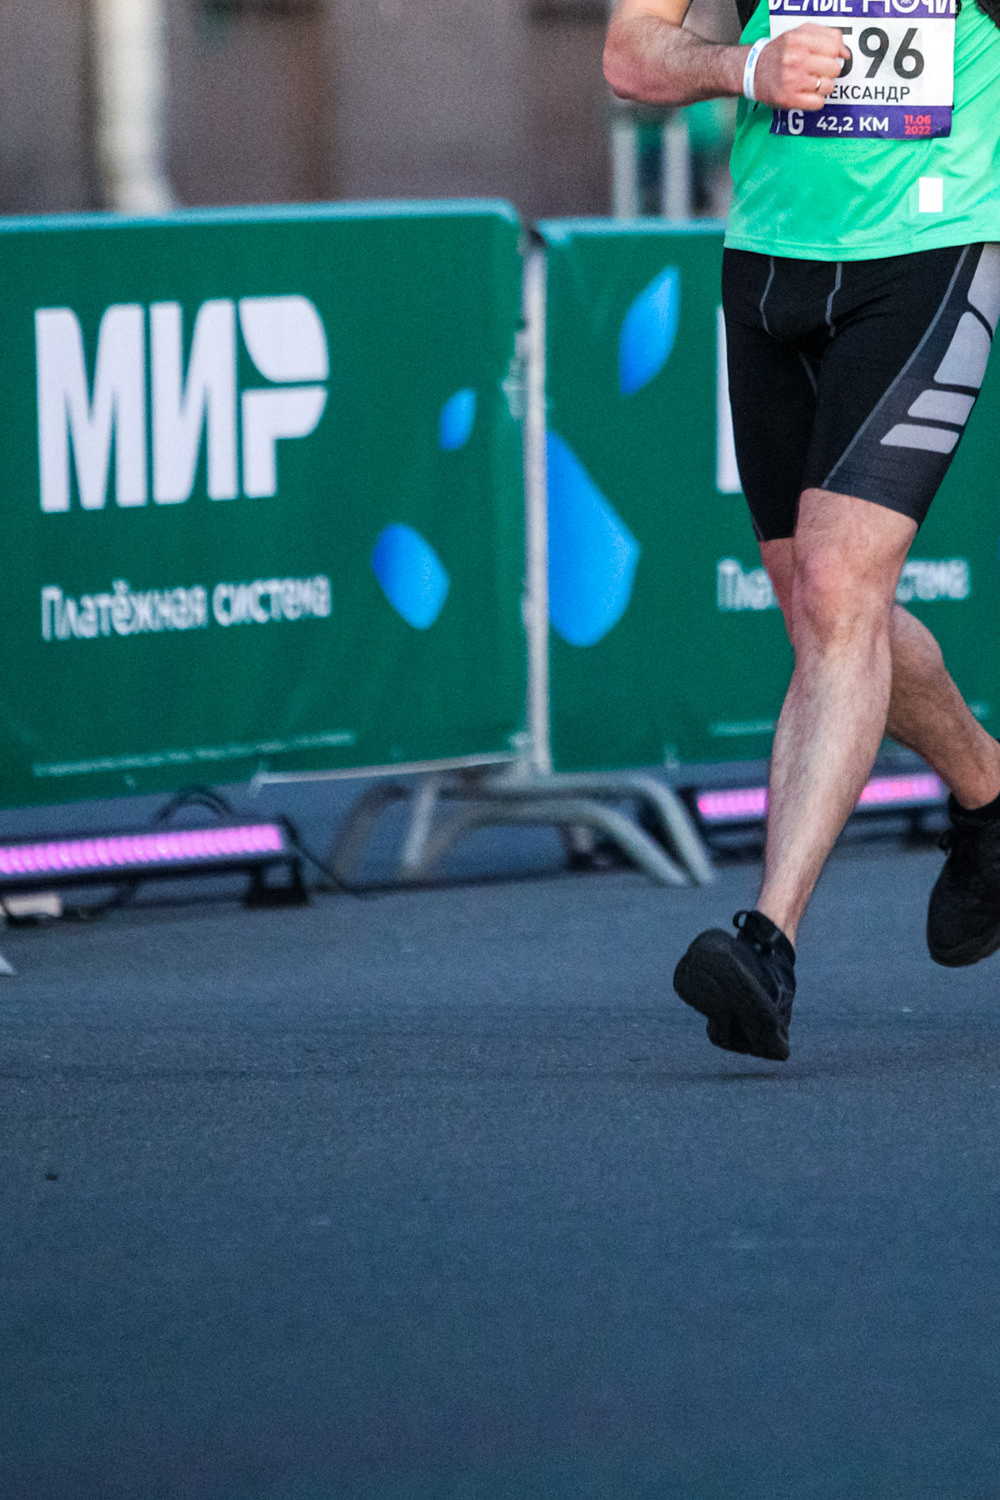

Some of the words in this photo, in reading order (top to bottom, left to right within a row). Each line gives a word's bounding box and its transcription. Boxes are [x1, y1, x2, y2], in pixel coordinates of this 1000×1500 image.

[787, 109, 805, 135] G
[816, 116, 854, 133] 42,2
[859, 116, 889, 132] КМ
[904, 114, 931, 125] 11.06
[904, 124, 931, 135] 2022
[34, 294, 331, 514] МИР
